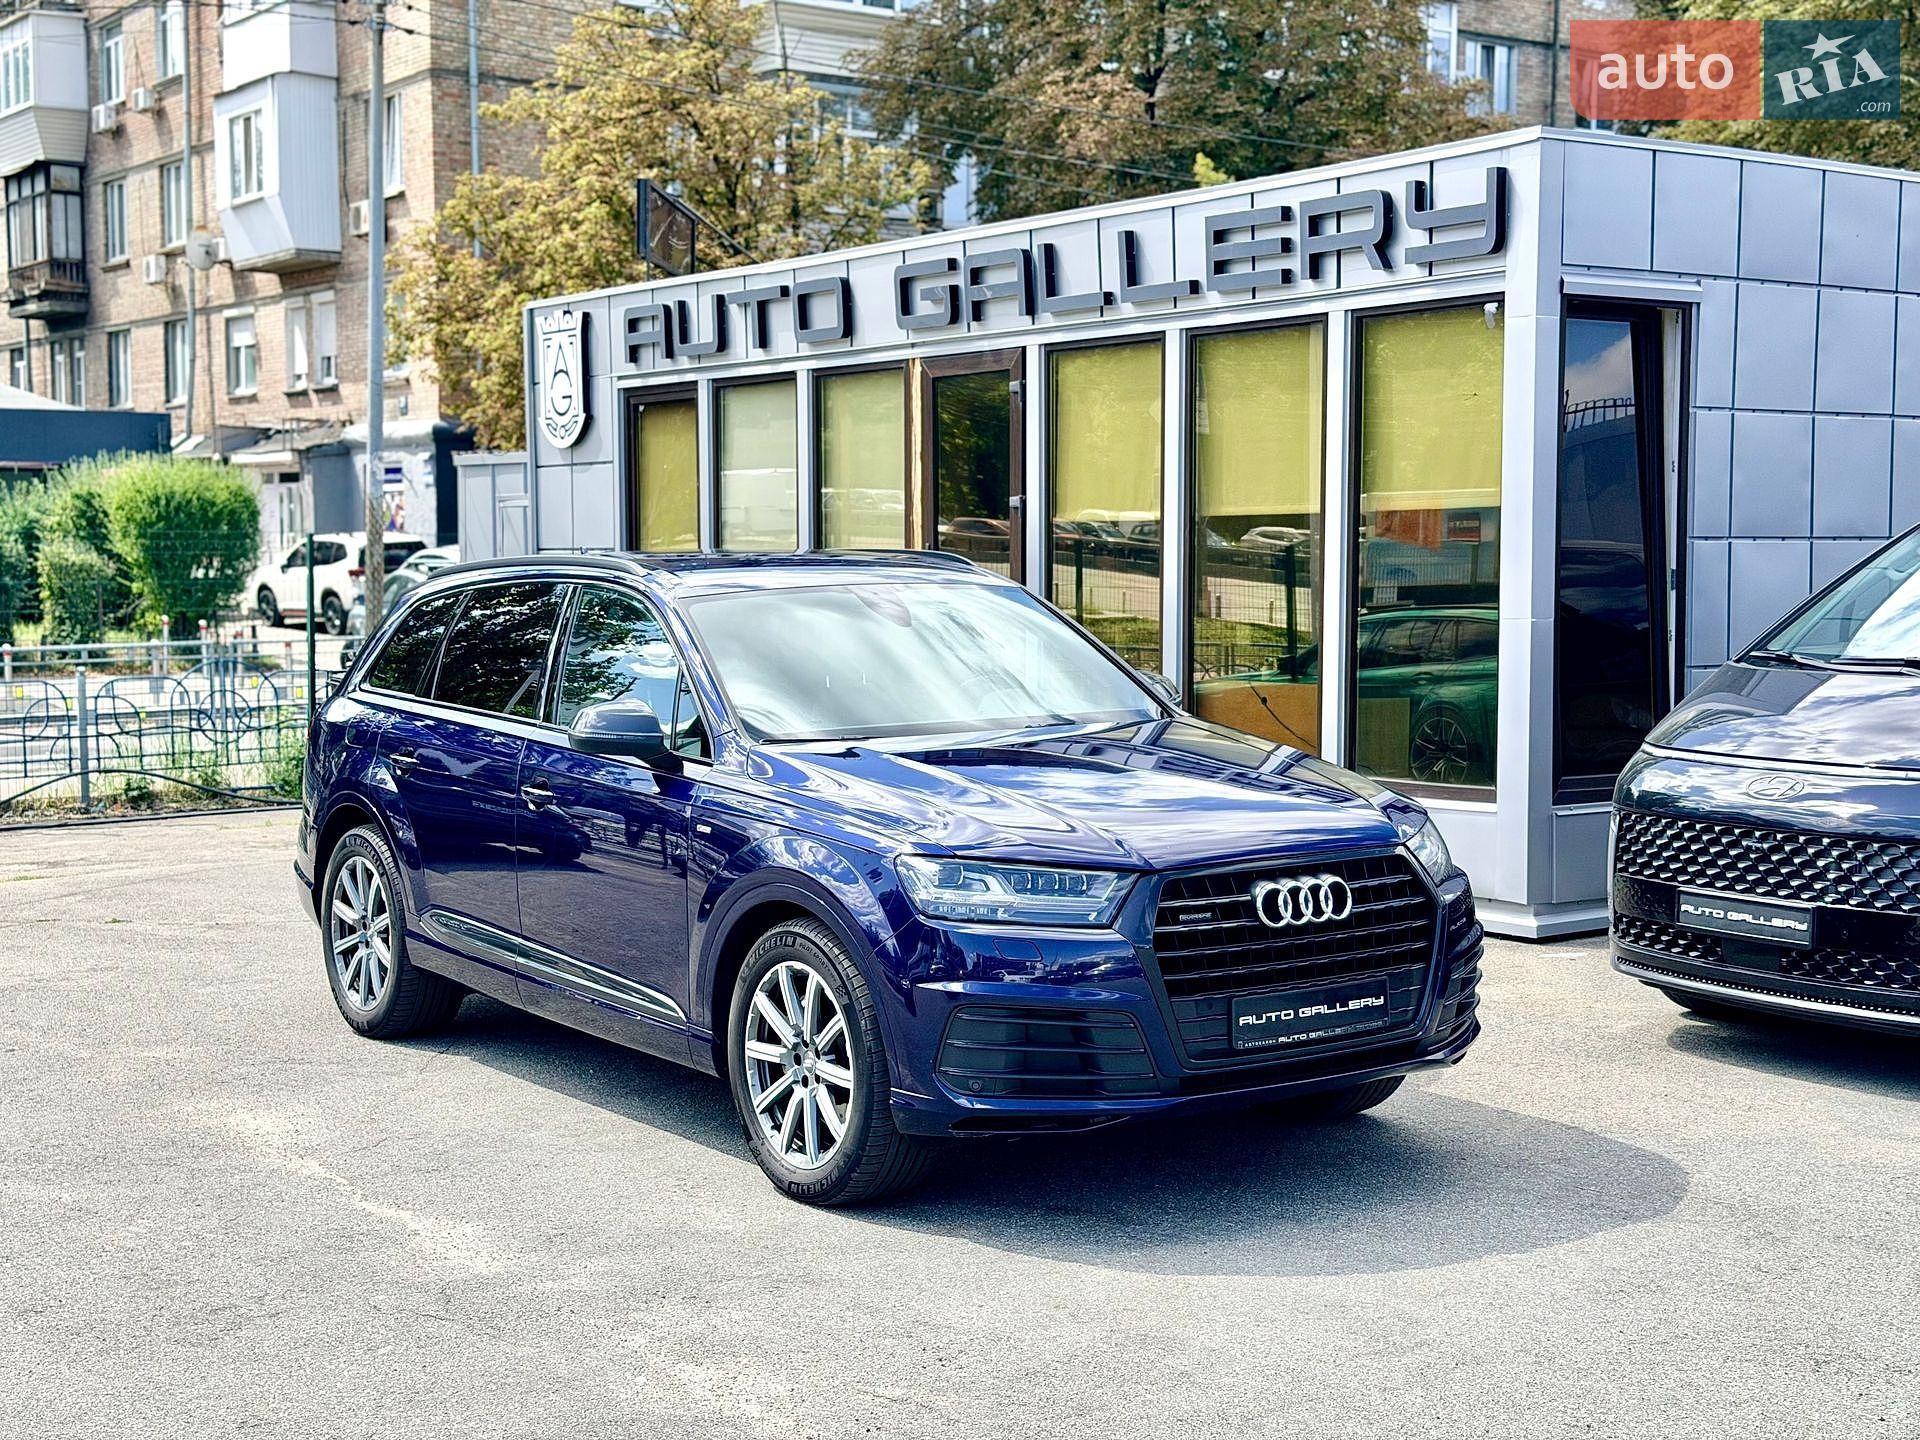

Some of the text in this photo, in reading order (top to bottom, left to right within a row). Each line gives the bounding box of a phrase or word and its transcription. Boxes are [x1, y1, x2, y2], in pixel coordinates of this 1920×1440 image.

[624, 166, 1507, 363] AUTO GALLERY
[1680, 903, 1808, 931] AUTO GALLERY
[748, 935, 795, 966] MICHELIN
[1238, 995, 1385, 1026] AUTO GALLERY
[1278, 1033, 1307, 1043] AUTO
[790, 1167, 840, 1195] MICHELIN
